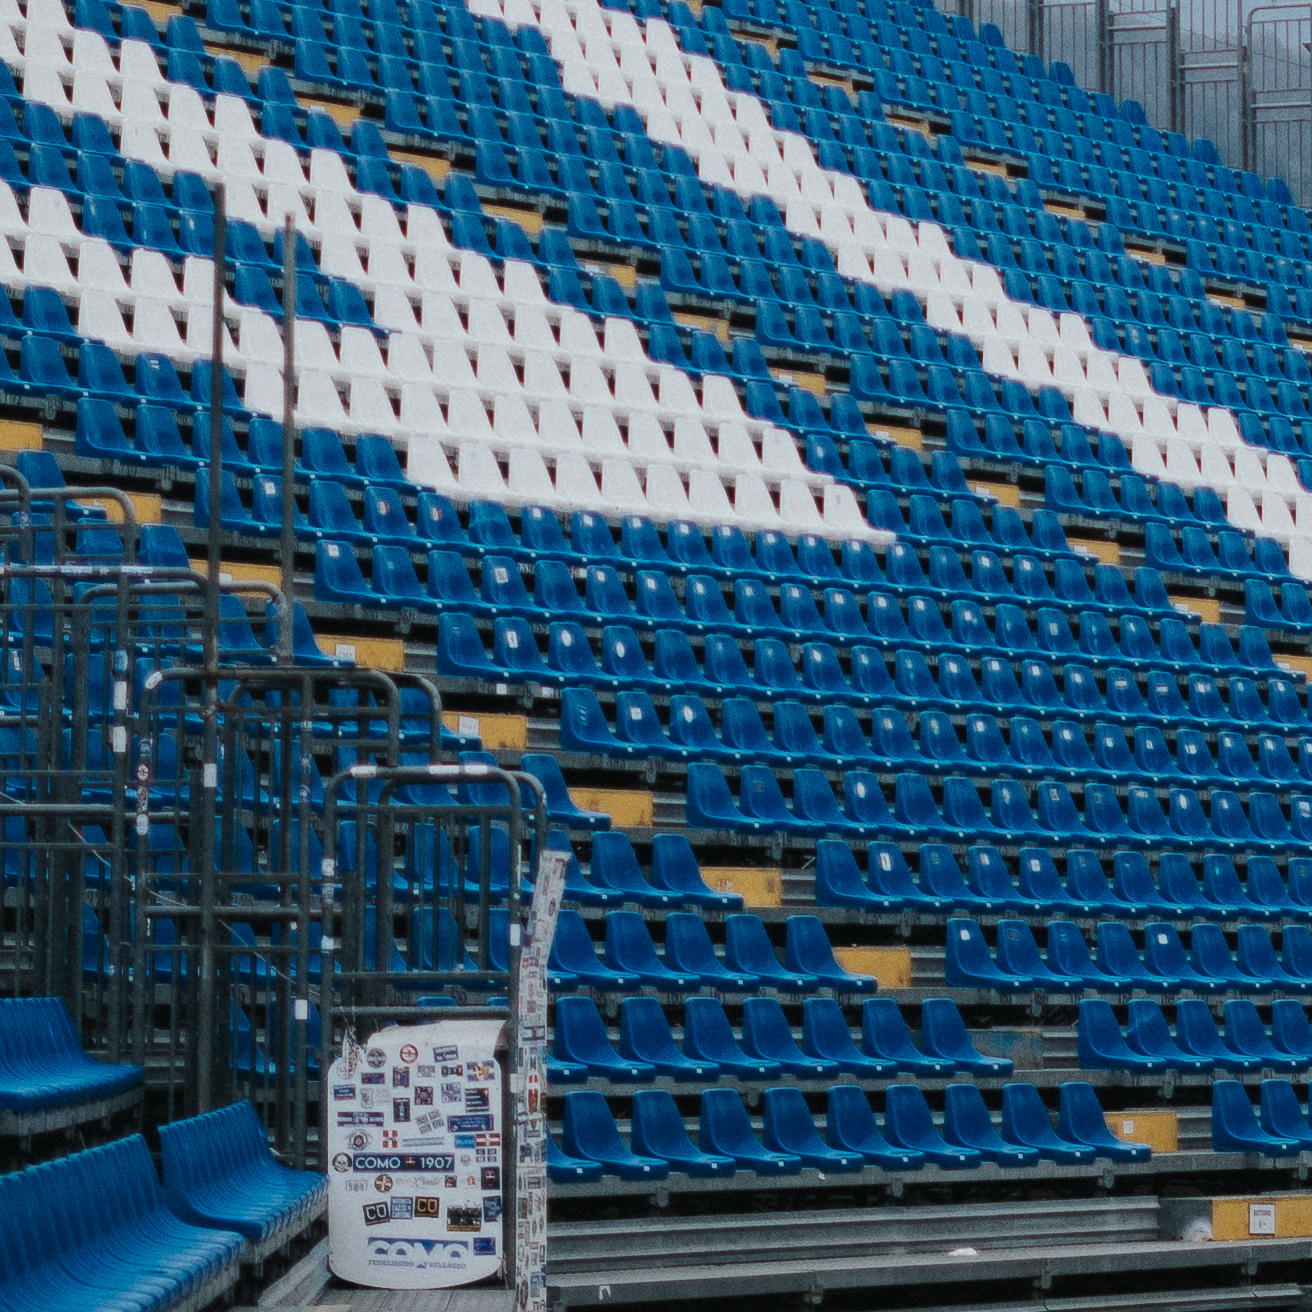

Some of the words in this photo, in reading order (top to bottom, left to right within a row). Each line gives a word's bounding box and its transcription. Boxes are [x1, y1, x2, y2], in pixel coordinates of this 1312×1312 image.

[355, 1156, 401, 1169] COMO
[420, 1156, 453, 1169] 1907
[366, 1204, 387, 1219] CO
[416, 1198, 438, 1212] CO
[367, 1239, 469, 1260] COMO
